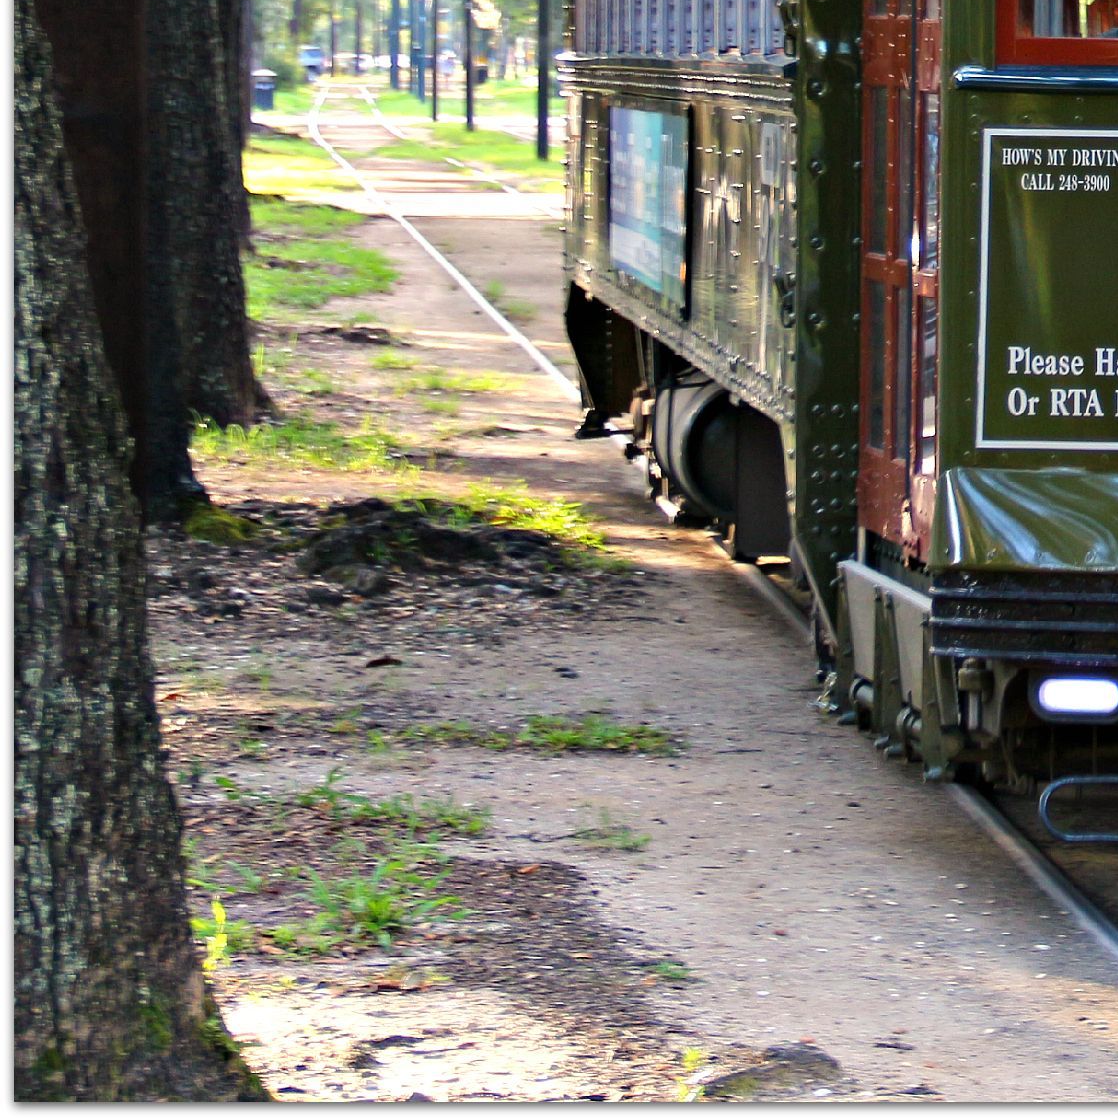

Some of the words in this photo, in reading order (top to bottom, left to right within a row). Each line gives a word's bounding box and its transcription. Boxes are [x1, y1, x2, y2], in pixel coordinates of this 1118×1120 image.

[1002, 148, 1042, 166] HOW'S
[1047, 148, 1067, 166] MY
[1021, 173, 1054, 190] CALL
[1059, 174, 1110, 192] 248-3900
[1007, 346, 1085, 376] Please
[1007, 387, 1040, 416] Or
[1050, 389, 1105, 417] RTA
